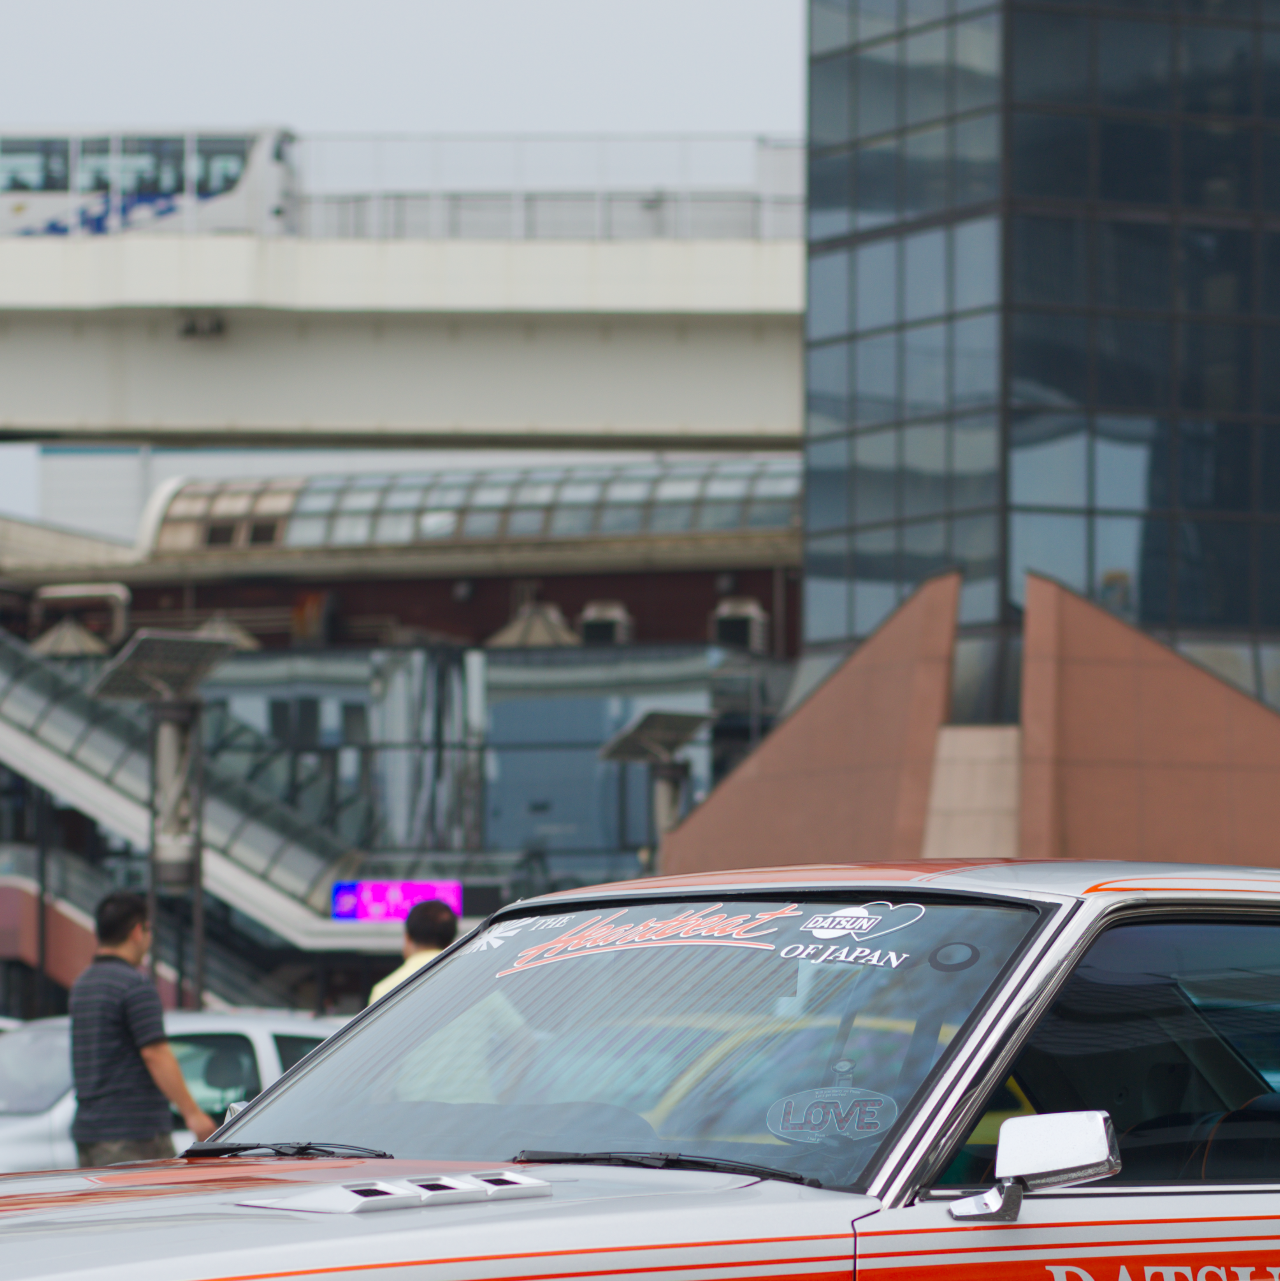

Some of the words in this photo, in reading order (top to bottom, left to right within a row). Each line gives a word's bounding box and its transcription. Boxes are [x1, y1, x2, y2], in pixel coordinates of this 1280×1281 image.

[514, 903, 803, 967] Heartbeat
[528, 915, 577, 931] THE
[807, 916, 877, 930] DATSUN
[780, 944, 823, 958] OF
[810, 946, 910, 969] JAPAN
[779, 1098, 884, 1132] LOVE
